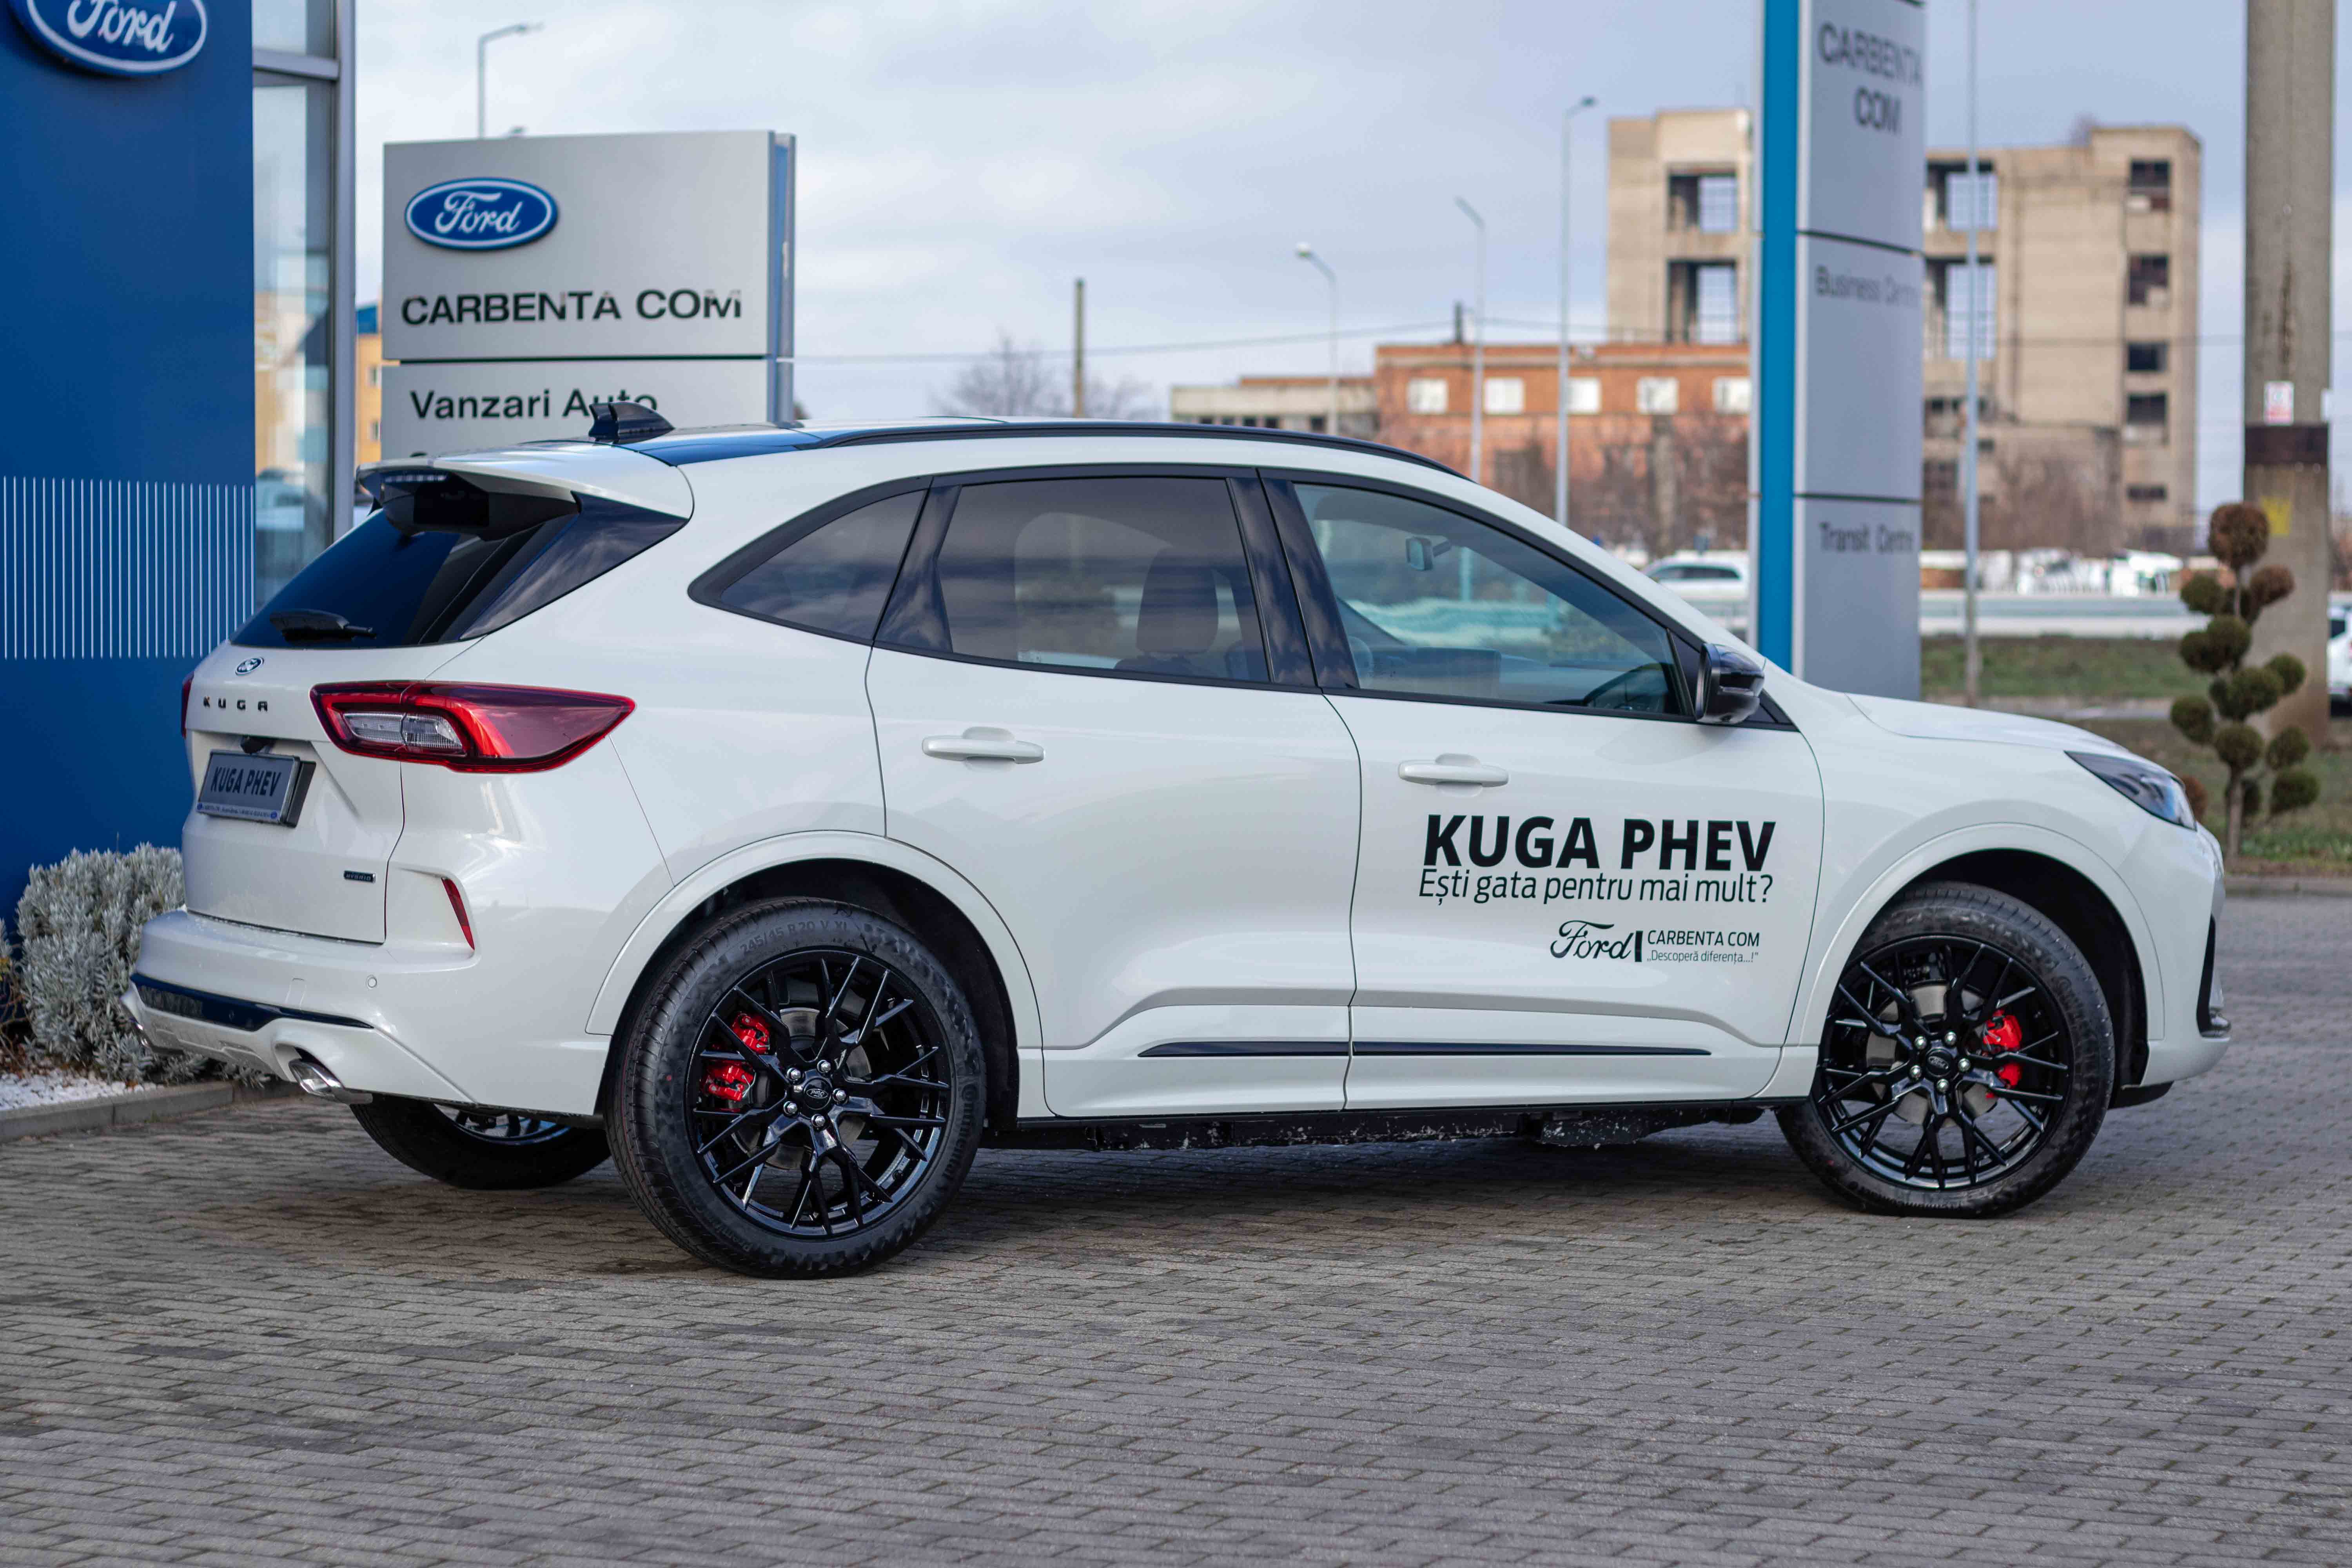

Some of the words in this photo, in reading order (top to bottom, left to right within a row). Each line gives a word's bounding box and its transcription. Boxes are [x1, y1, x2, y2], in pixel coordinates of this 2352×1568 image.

[1819, 23, 1922, 86] CARBENTA
[1855, 87, 1901, 133] COM
[435, 191, 521, 234] Ford
[401, 292, 621, 326] CARBENTA
[636, 289, 742, 319] COM
[410, 389, 550, 419] Vanzari
[1819, 521, 1869, 553] Transit
[203, 697, 268, 712] KUGA
[211, 766, 244, 794] KUGA
[243, 769, 281, 797] PHEV
[1423, 814, 1600, 869] KUGA
[1621, 818, 1776, 871] PHEV
[1419, 868, 1470, 906] Ești
[1474, 871, 1536, 904] gata
[1543, 873, 1633, 905] pentru
[1639, 874, 1689, 901] mai
[1695, 873, 1773, 903] mult?
[1550, 920, 1634, 959] Ford
[1648, 929, 1724, 946] CARBENTA
[1728, 931, 1760, 947] COM
